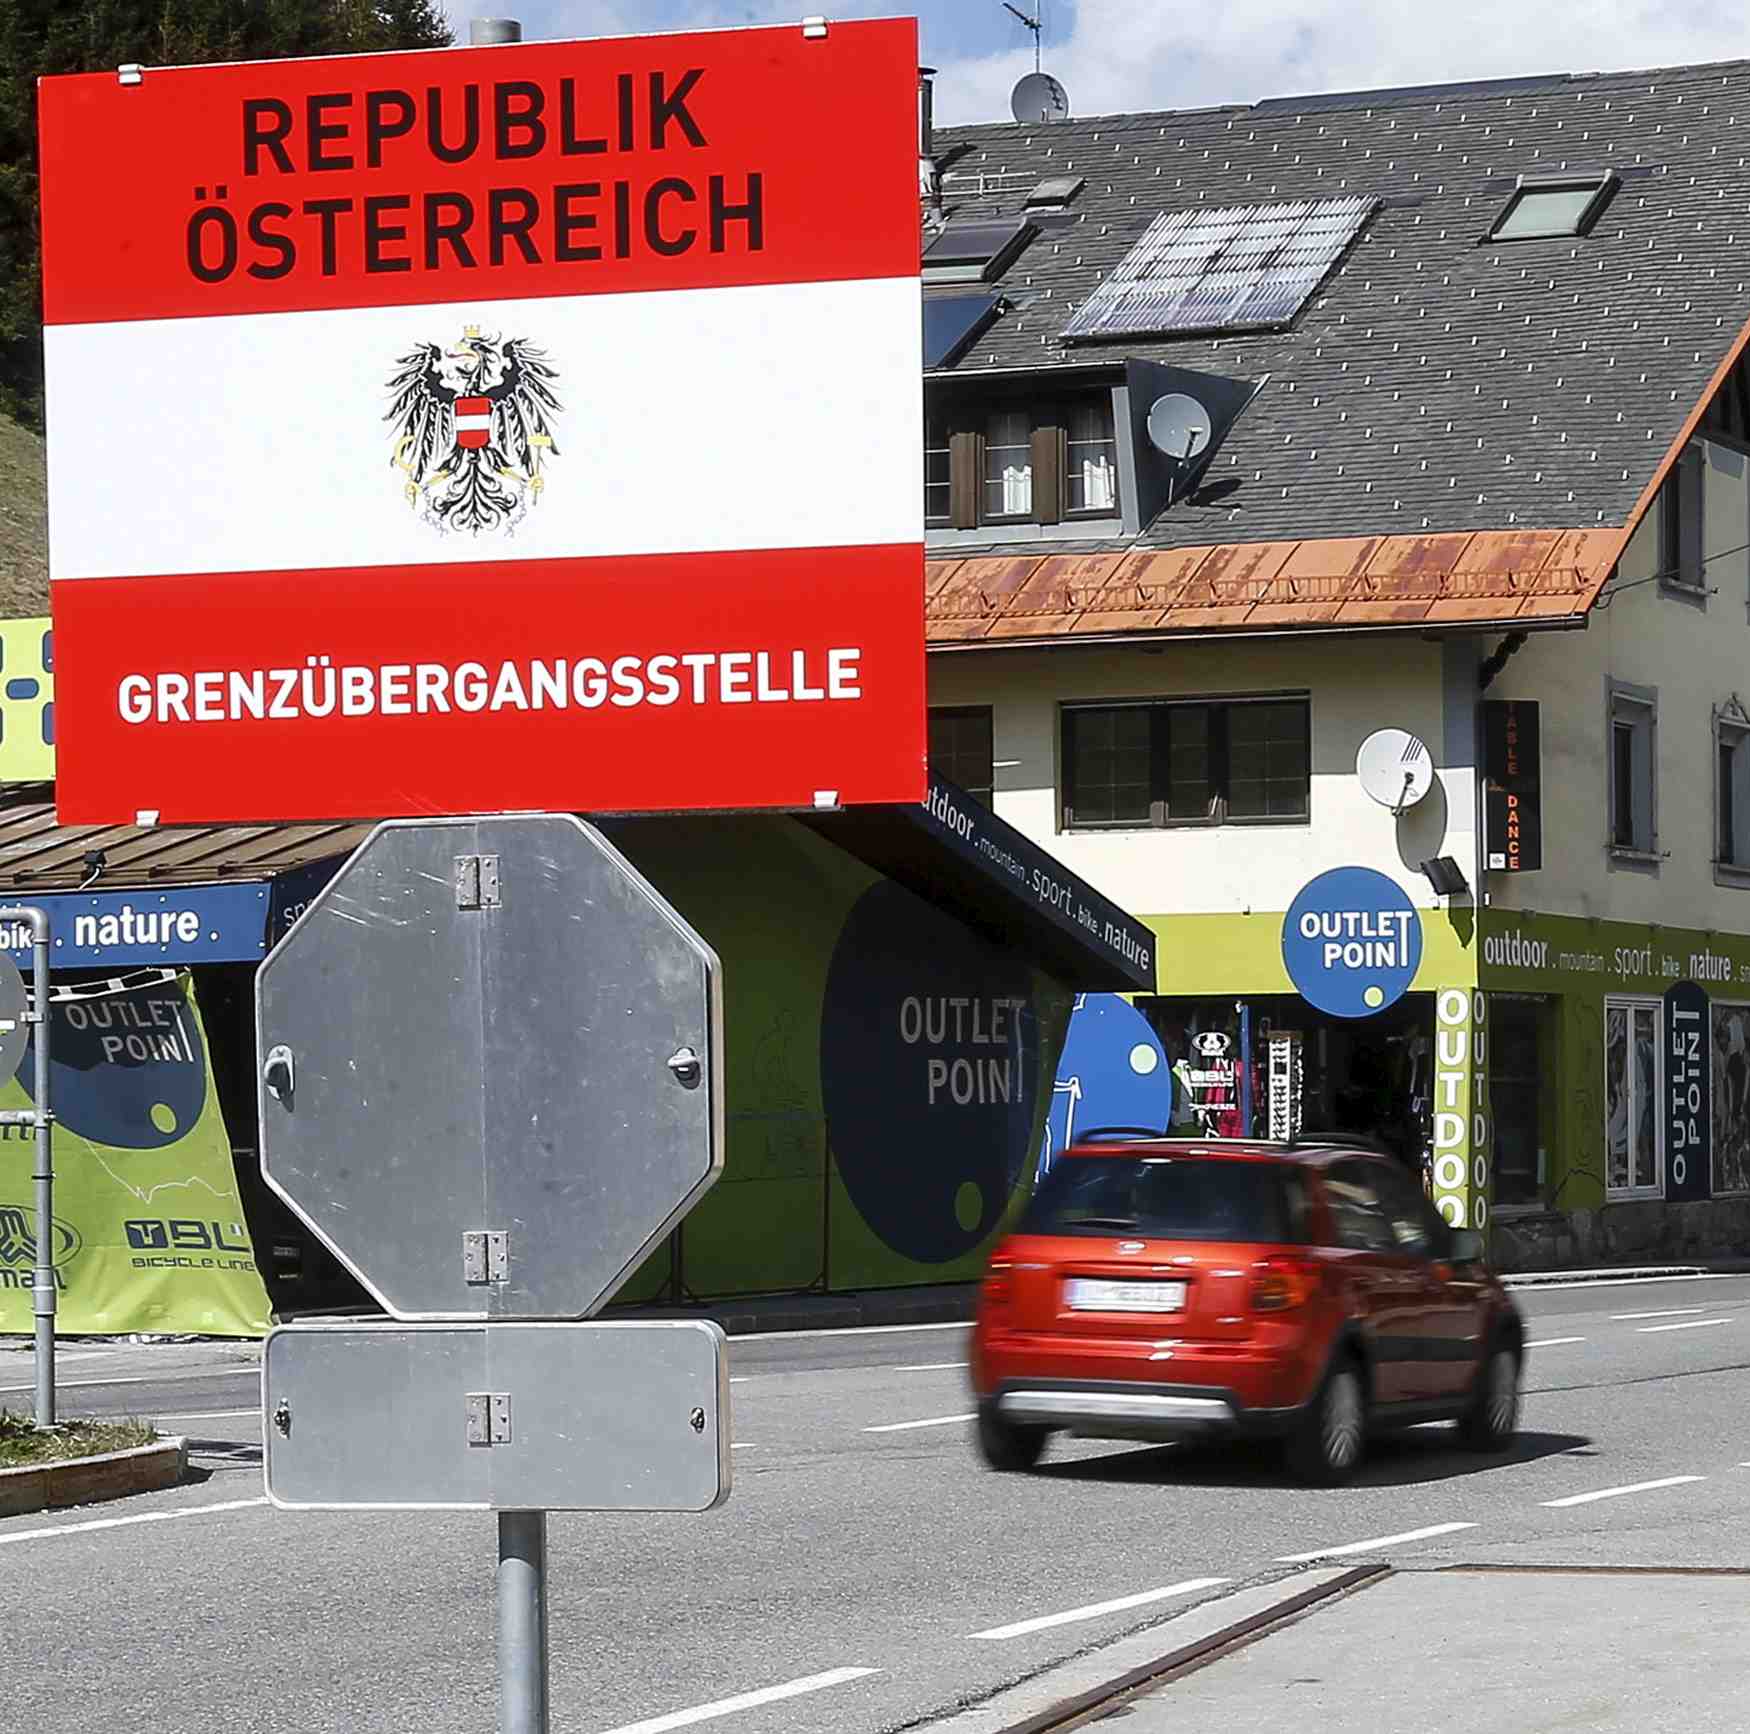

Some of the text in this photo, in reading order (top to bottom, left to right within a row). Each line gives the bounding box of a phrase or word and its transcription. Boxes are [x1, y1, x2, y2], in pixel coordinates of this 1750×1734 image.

[242, 68, 709, 177] REPUBLIK
[186, 172, 764, 284] ÖSTERREICH
[117, 647, 862, 725] GRENZÜBERGANGSSTELLE
[1508, 795, 1519, 869] DANCE
[921, 785, 1150, 970] utdoor mountain sport bike nature
[0, 905, 200, 950] bik nature
[1300, 911, 1413, 942] OUTLET
[1484, 930, 1548, 969] outdoor
[1559, 951, 1603, 972] mountain
[1615, 944, 1652, 981] sport
[1662, 956, 1680, 978] bike
[1689, 949, 1731, 981] nature
[65, 1001, 182, 1034] OUTLET
[900, 996, 1026, 1048] OUTLET
[1434, 989, 1469, 1229] OUTDOO
[1473, 991, 1486, 1230] OUTDOO
[1673, 1001, 1690, 1184] OUTLET
